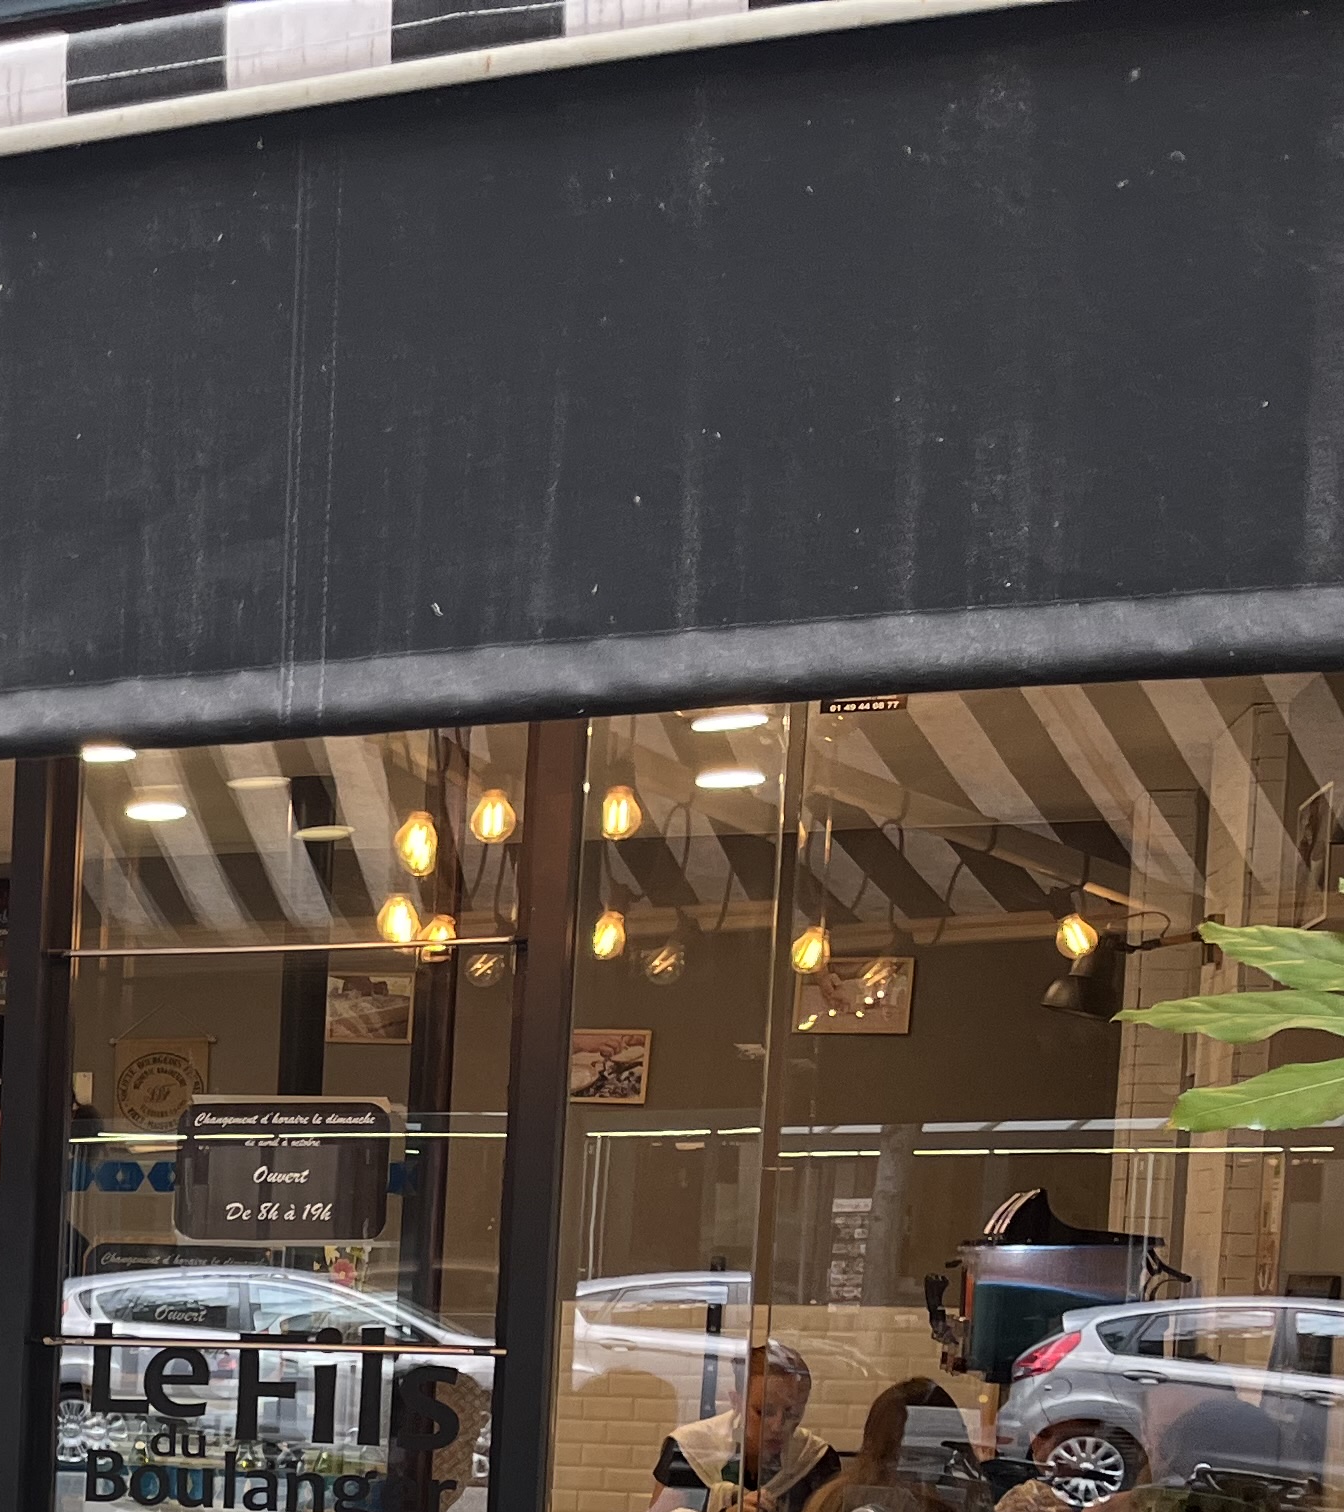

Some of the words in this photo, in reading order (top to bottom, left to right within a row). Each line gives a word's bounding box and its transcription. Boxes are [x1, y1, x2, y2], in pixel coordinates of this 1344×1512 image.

[194, 1111, 257, 1127] Changement
[312, 1112, 322, 1125] le
[325, 1111, 375, 1126] dimanche
[253, 1166, 310, 1184] Ouvert
[226, 1202, 252, 1221] De
[257, 1202, 278, 1221] 8h
[283, 1200, 298, 1221] à
[301, 1202, 333, 1222] 19h
[154, 1304, 208, 1322] Ouvert
[91, 1323, 210, 1417] Le
[235, 1327, 460, 1451] Fils
[150, 1424, 206, 1458] du
